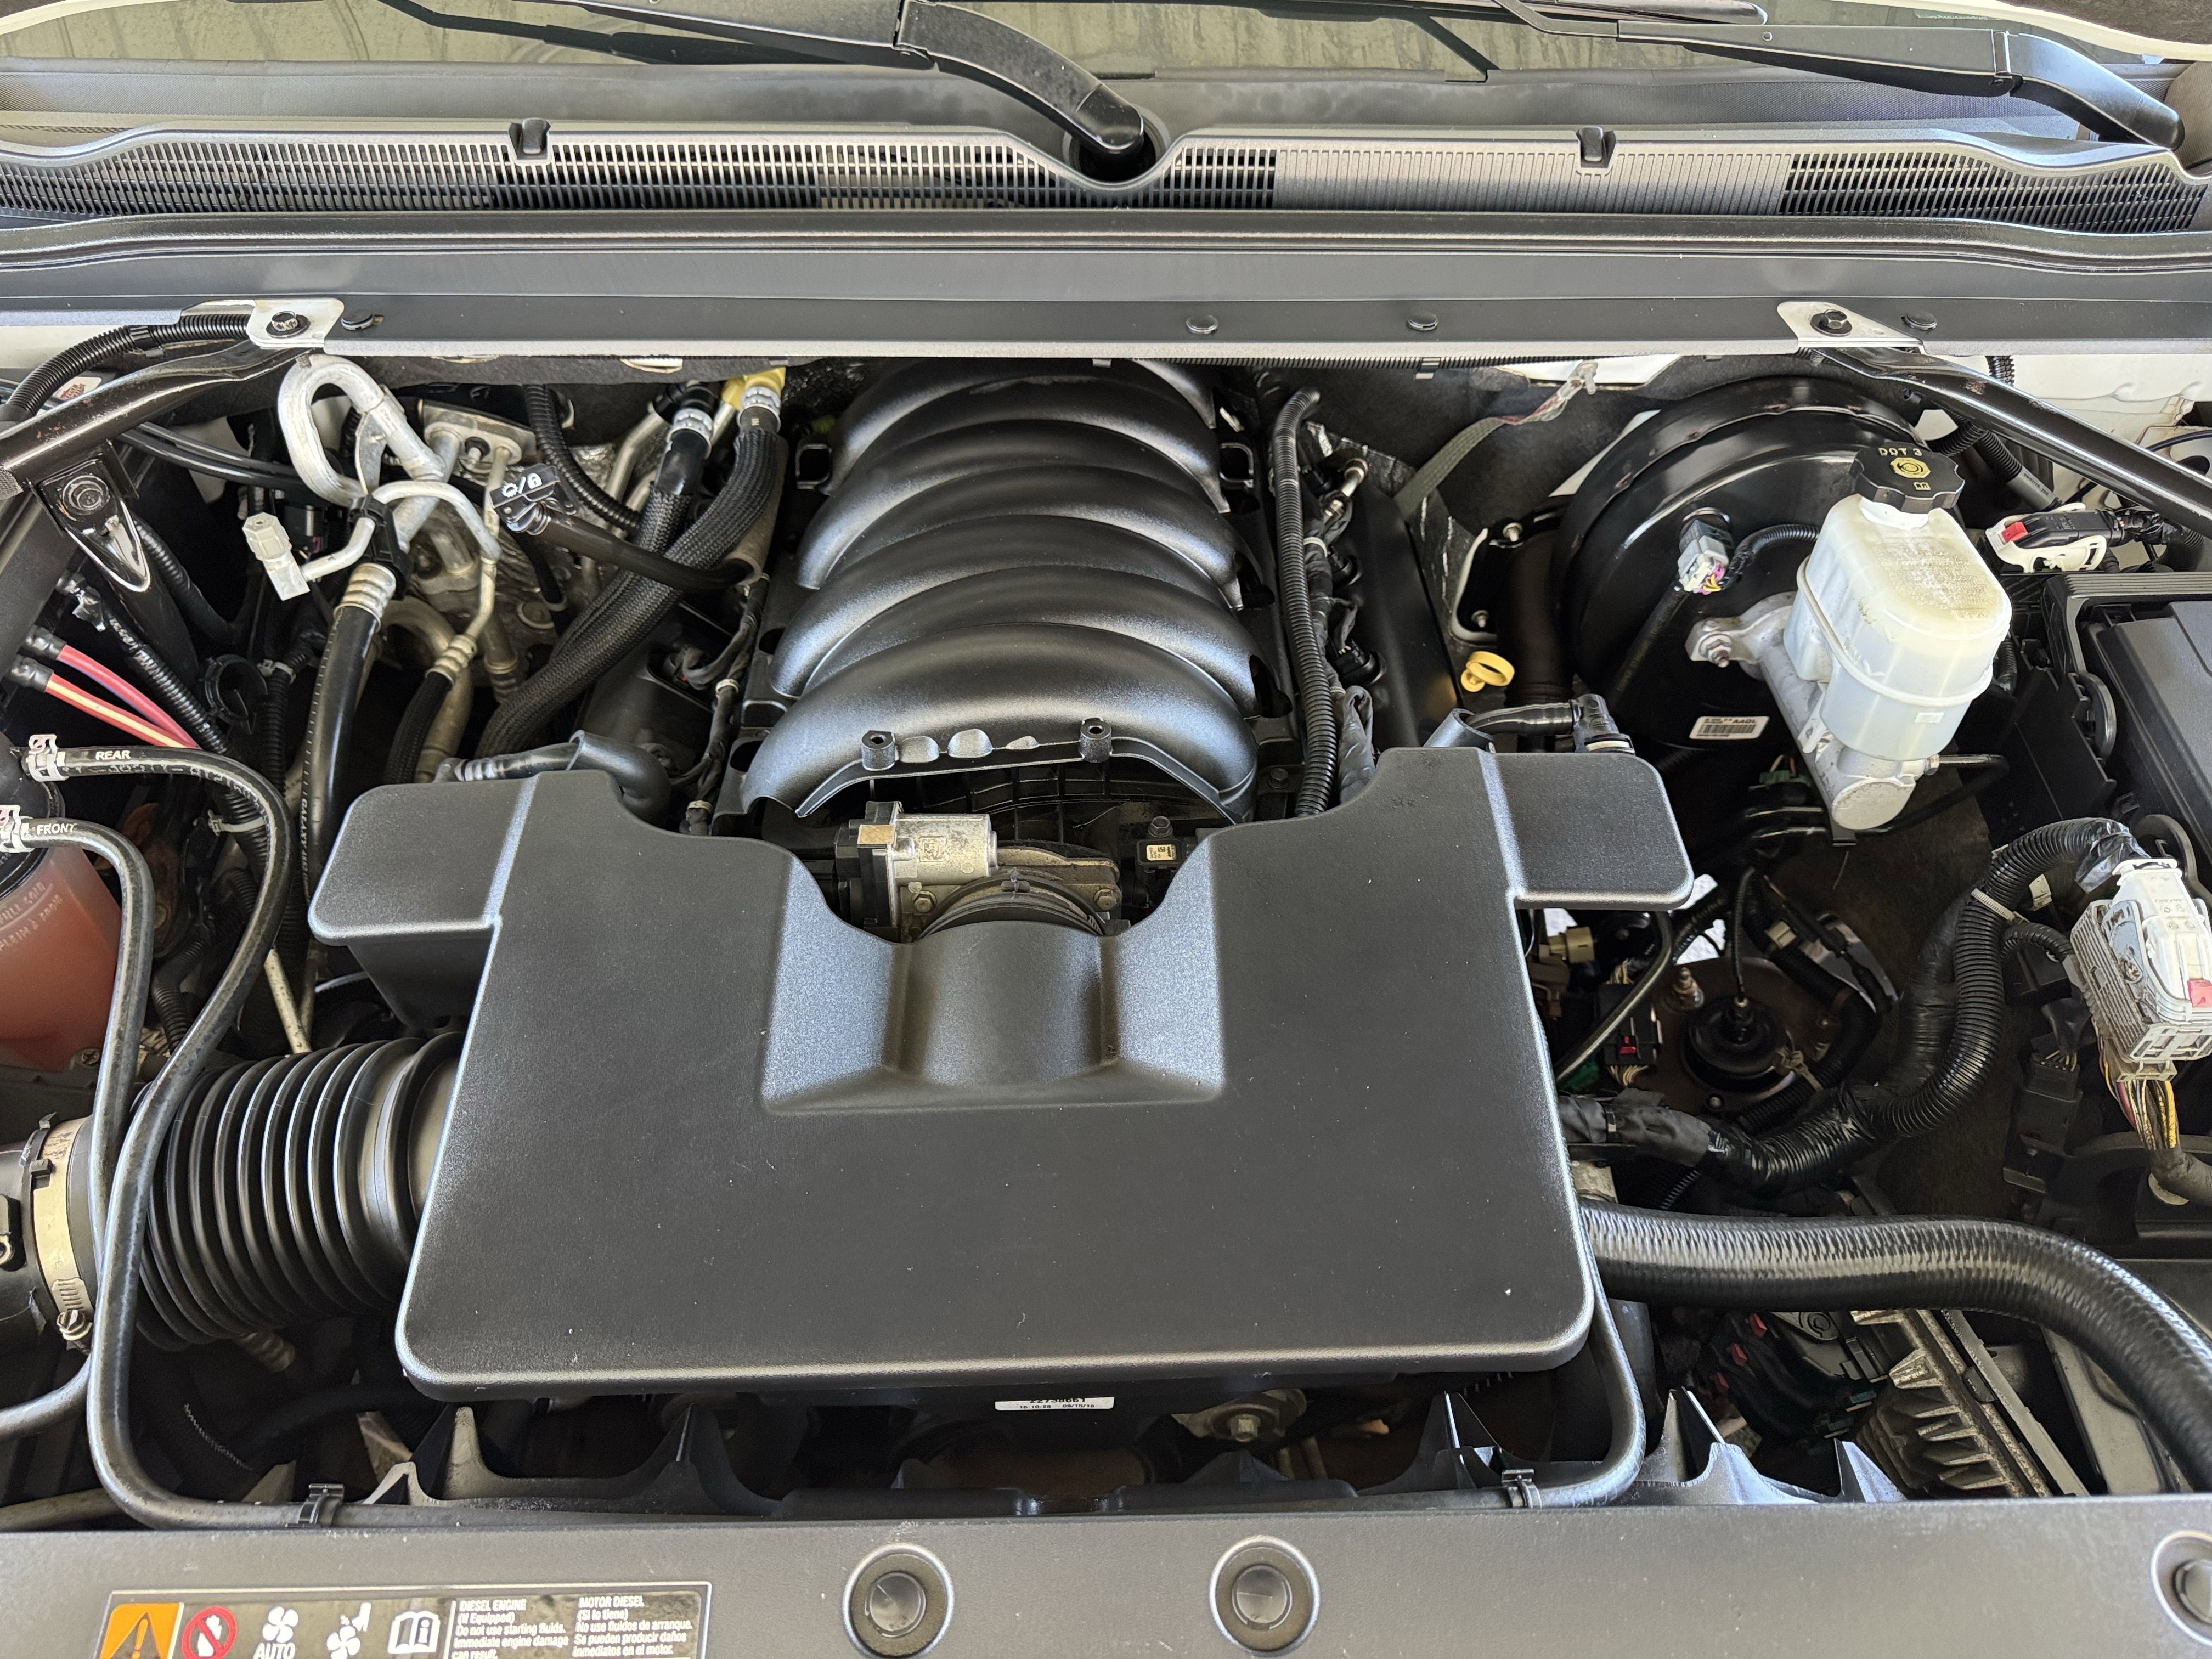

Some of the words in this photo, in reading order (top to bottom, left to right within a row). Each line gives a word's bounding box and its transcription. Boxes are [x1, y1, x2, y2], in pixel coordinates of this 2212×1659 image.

[1878, 448, 1907, 456] DOT
[95, 751, 131, 760] REAR
[37, 823, 77, 835] FRONT
[459, 1600, 491, 1611] DIESEL
[493, 1599, 527, 1611] ENGINE
[579, 1597, 612, 1608] MOTOR
[613, 1596, 645, 1607] DIESEL
[455, 1626, 469, 1637] Do
[470, 1625, 484, 1635] not
[486, 1626, 502, 1635] use
[503, 1623, 537, 1636] starting
[575, 1622, 589, 1633] No
[590, 1622, 607, 1632] use
[639, 1620, 651, 1630] de
[453, 1637, 501, 1648] Immediate
[501, 1635, 532, 1649] engine
[533, 1635, 569, 1648] damage
[574, 1633, 587, 1645] Se
[588, 1633, 620, 1646] pueden
[621, 1632, 659, 1645] producir
[253, 1642, 296, 1659] AUTO
[622, 1646, 634, 1656] en
[635, 1644, 645, 1655] el
